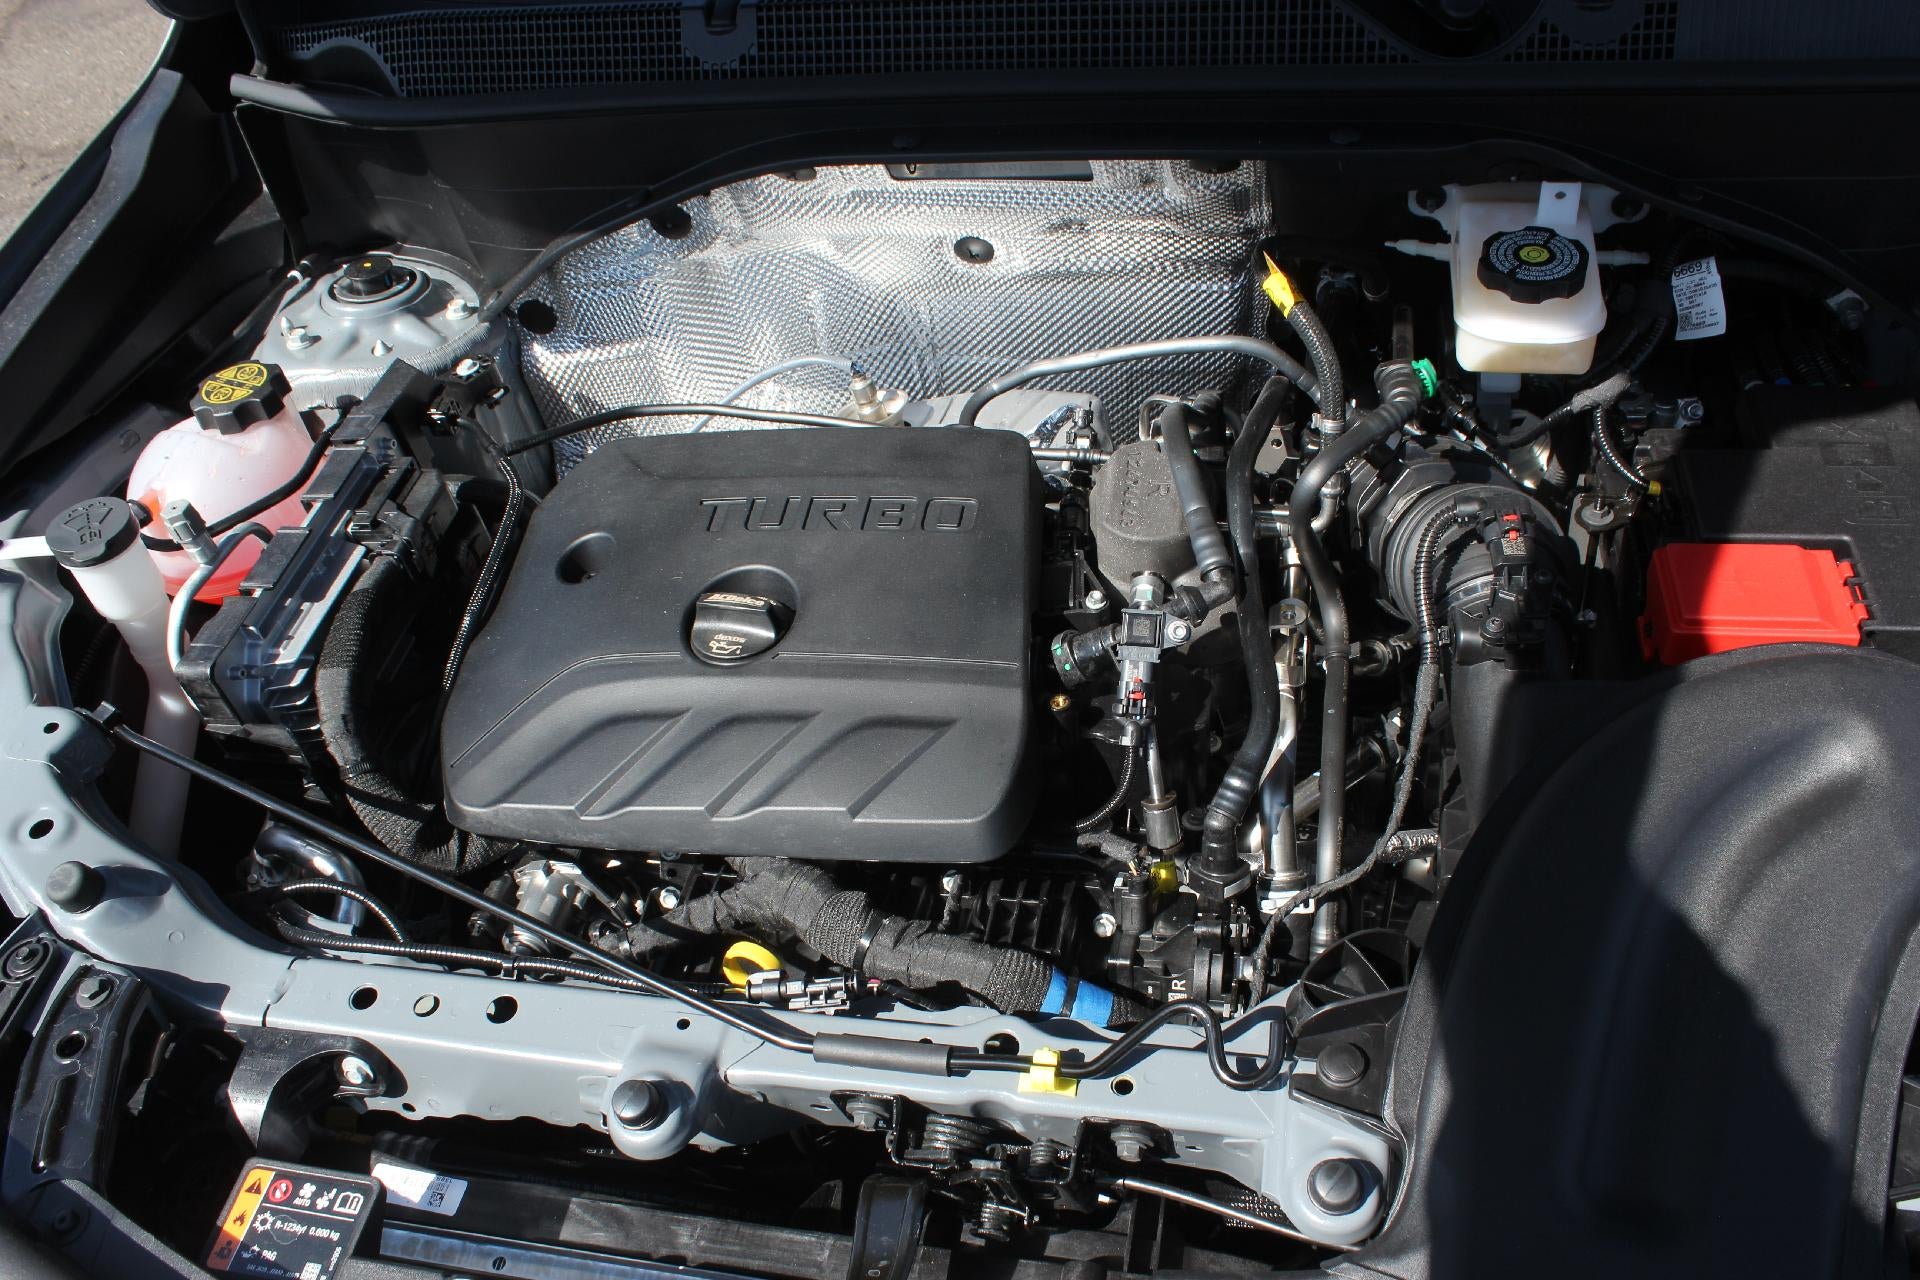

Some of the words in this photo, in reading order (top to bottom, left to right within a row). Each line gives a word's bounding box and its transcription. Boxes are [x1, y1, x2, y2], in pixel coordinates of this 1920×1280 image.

[1674, 261, 1702, 277] 6669
[699, 495, 978, 532] TURBO
[705, 592, 765, 607] ACDelco
[293, 1196, 311, 1207] AUTO
[330, 1229, 341, 1242] kg
[262, 1248, 278, 1262] PAG
